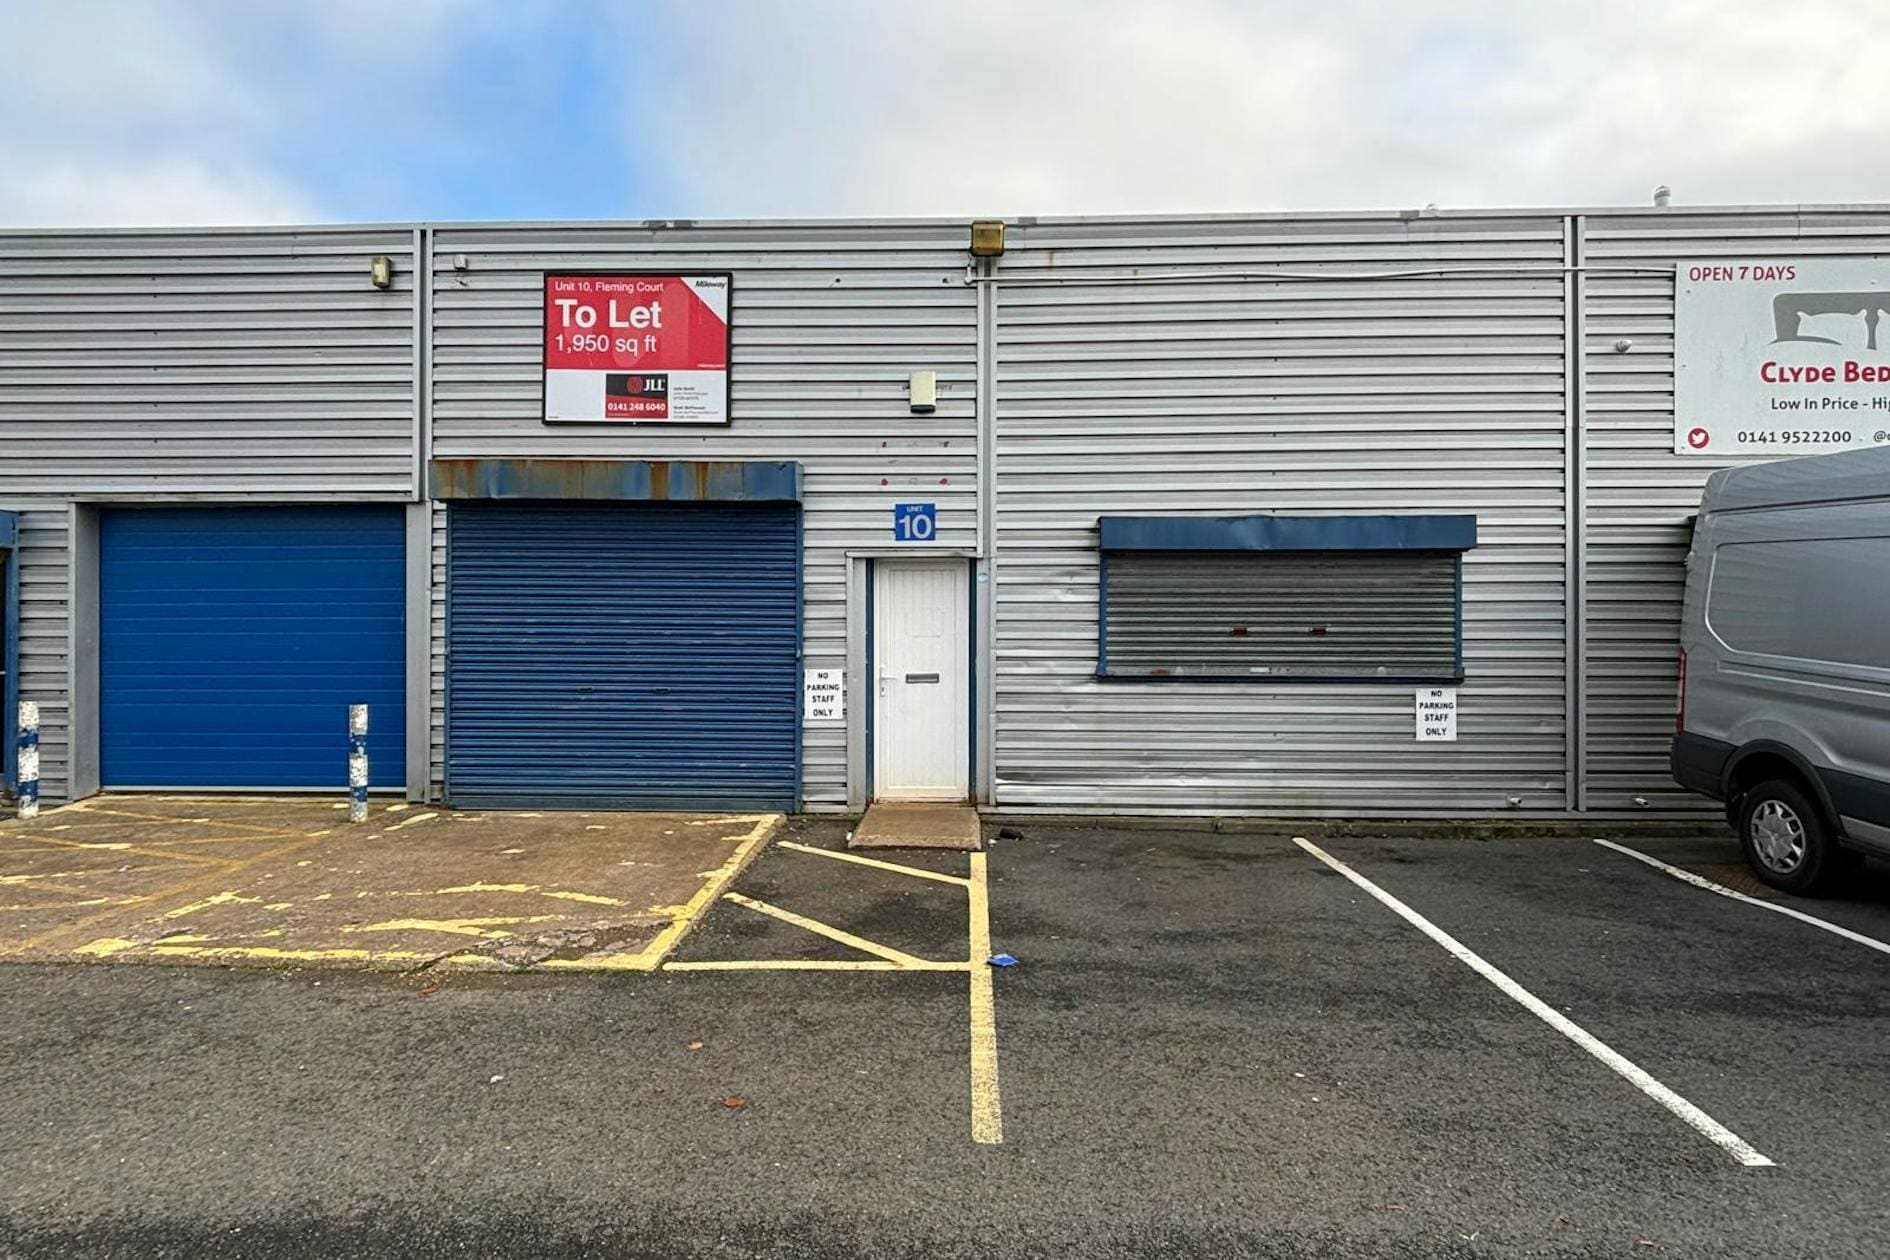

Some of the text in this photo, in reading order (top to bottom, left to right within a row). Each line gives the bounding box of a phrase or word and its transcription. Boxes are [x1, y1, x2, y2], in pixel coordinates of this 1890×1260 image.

[1689, 266, 1796, 281] OPEN 7 DAYS
[555, 281, 575, 292] Unit
[595, 281, 634, 294] Fleming
[636, 281, 664, 292] Court
[555, 299, 662, 328] To Let
[555, 334, 657, 356] 1,950 sq ft
[643, 379, 665, 392] JLL
[607, 403, 628, 411] 0141
[629, 403, 644, 411] 248
[645, 403, 666, 411] 6040
[1771, 397, 1800, 410] Low
[1804, 397, 1817, 409] In
[1822, 397, 1858, 410] Price
[1872, 396, 1890, 412] Hi
[1738, 431, 1777, 443] 0141
[1782, 431, 1851, 443] 9522200
[899, 514, 932, 539] 10
[812, 695, 834, 703] STAFF
[813, 709, 833, 717] ONLY
[1425, 713, 1449, 722] STAFF
[1426, 728, 1447, 736] ONLY
